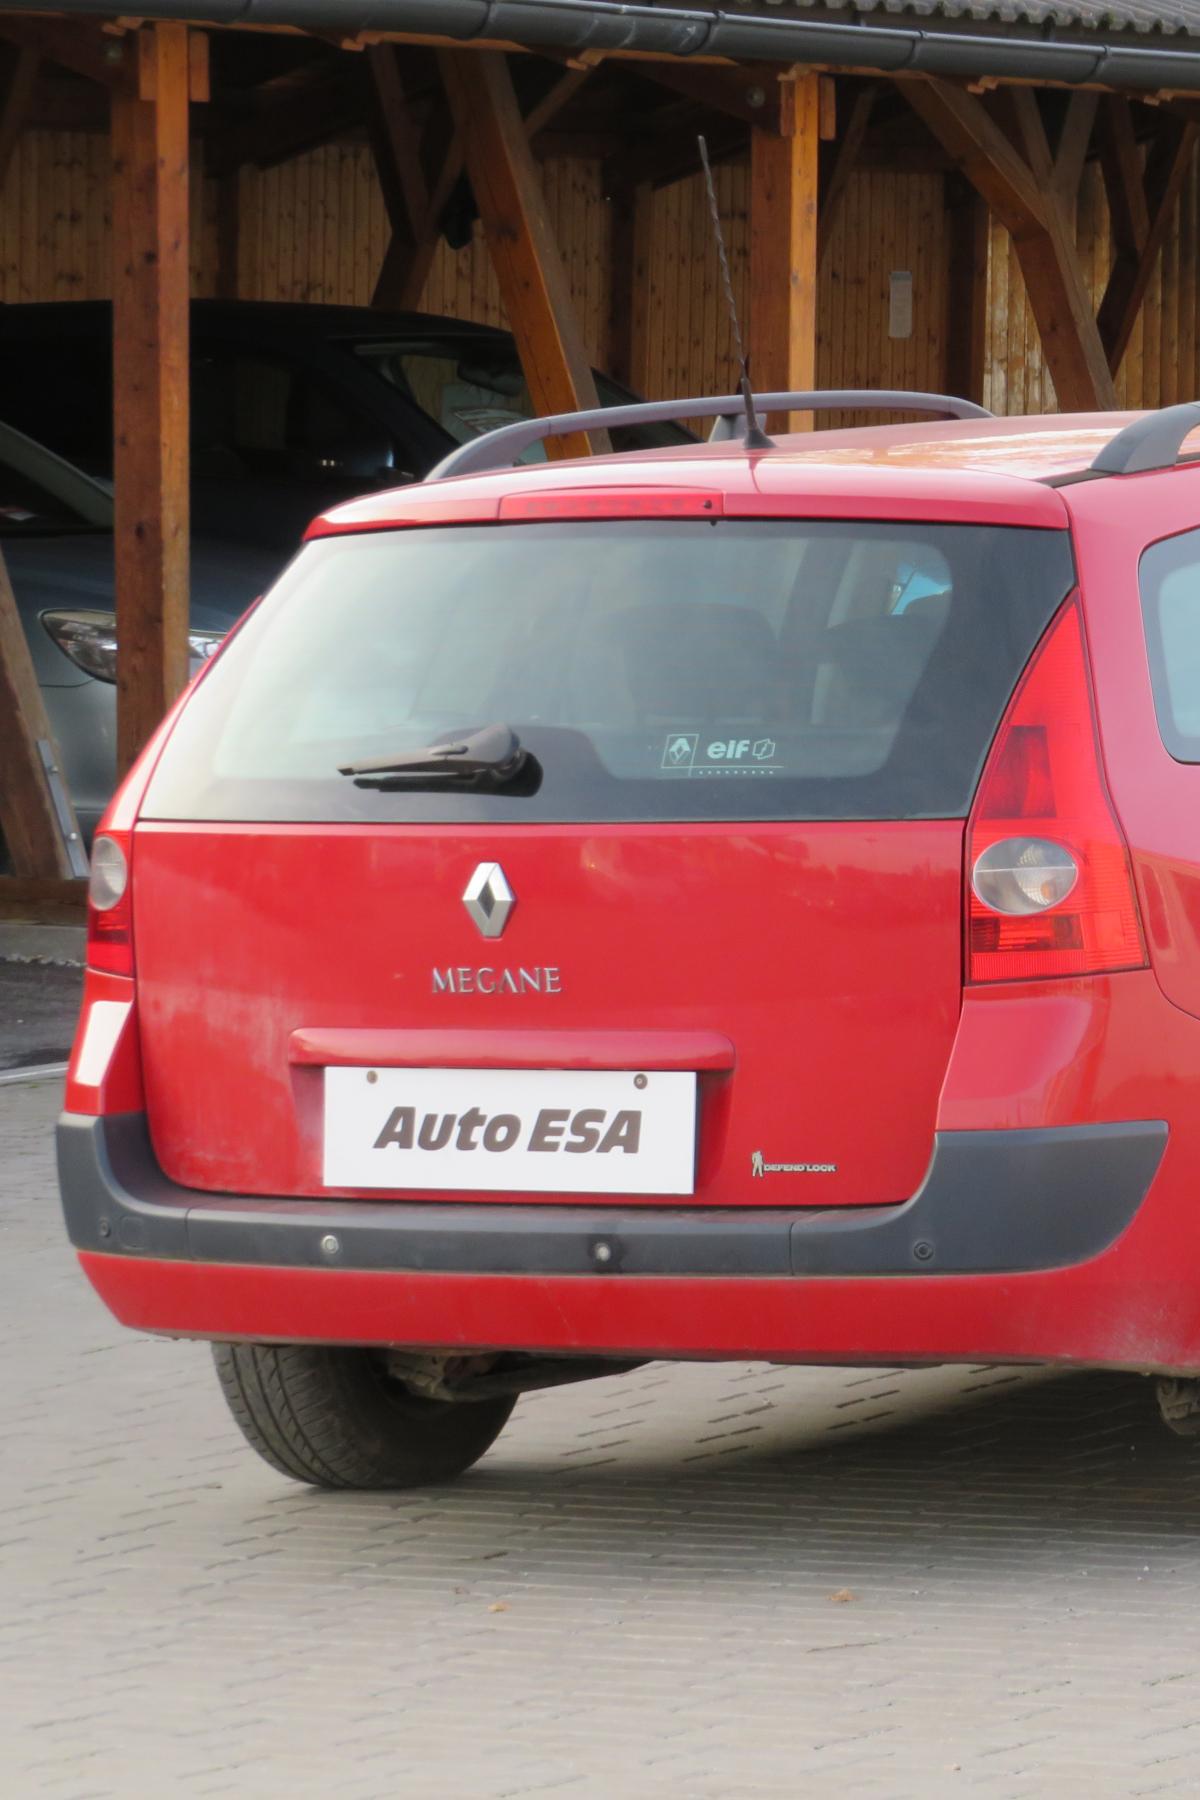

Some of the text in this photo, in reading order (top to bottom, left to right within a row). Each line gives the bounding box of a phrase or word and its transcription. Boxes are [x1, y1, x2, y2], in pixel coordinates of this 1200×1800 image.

[707, 739, 751, 760] elf
[431, 966, 563, 994] MEGANE
[372, 1106, 642, 1154] Auto ESA
